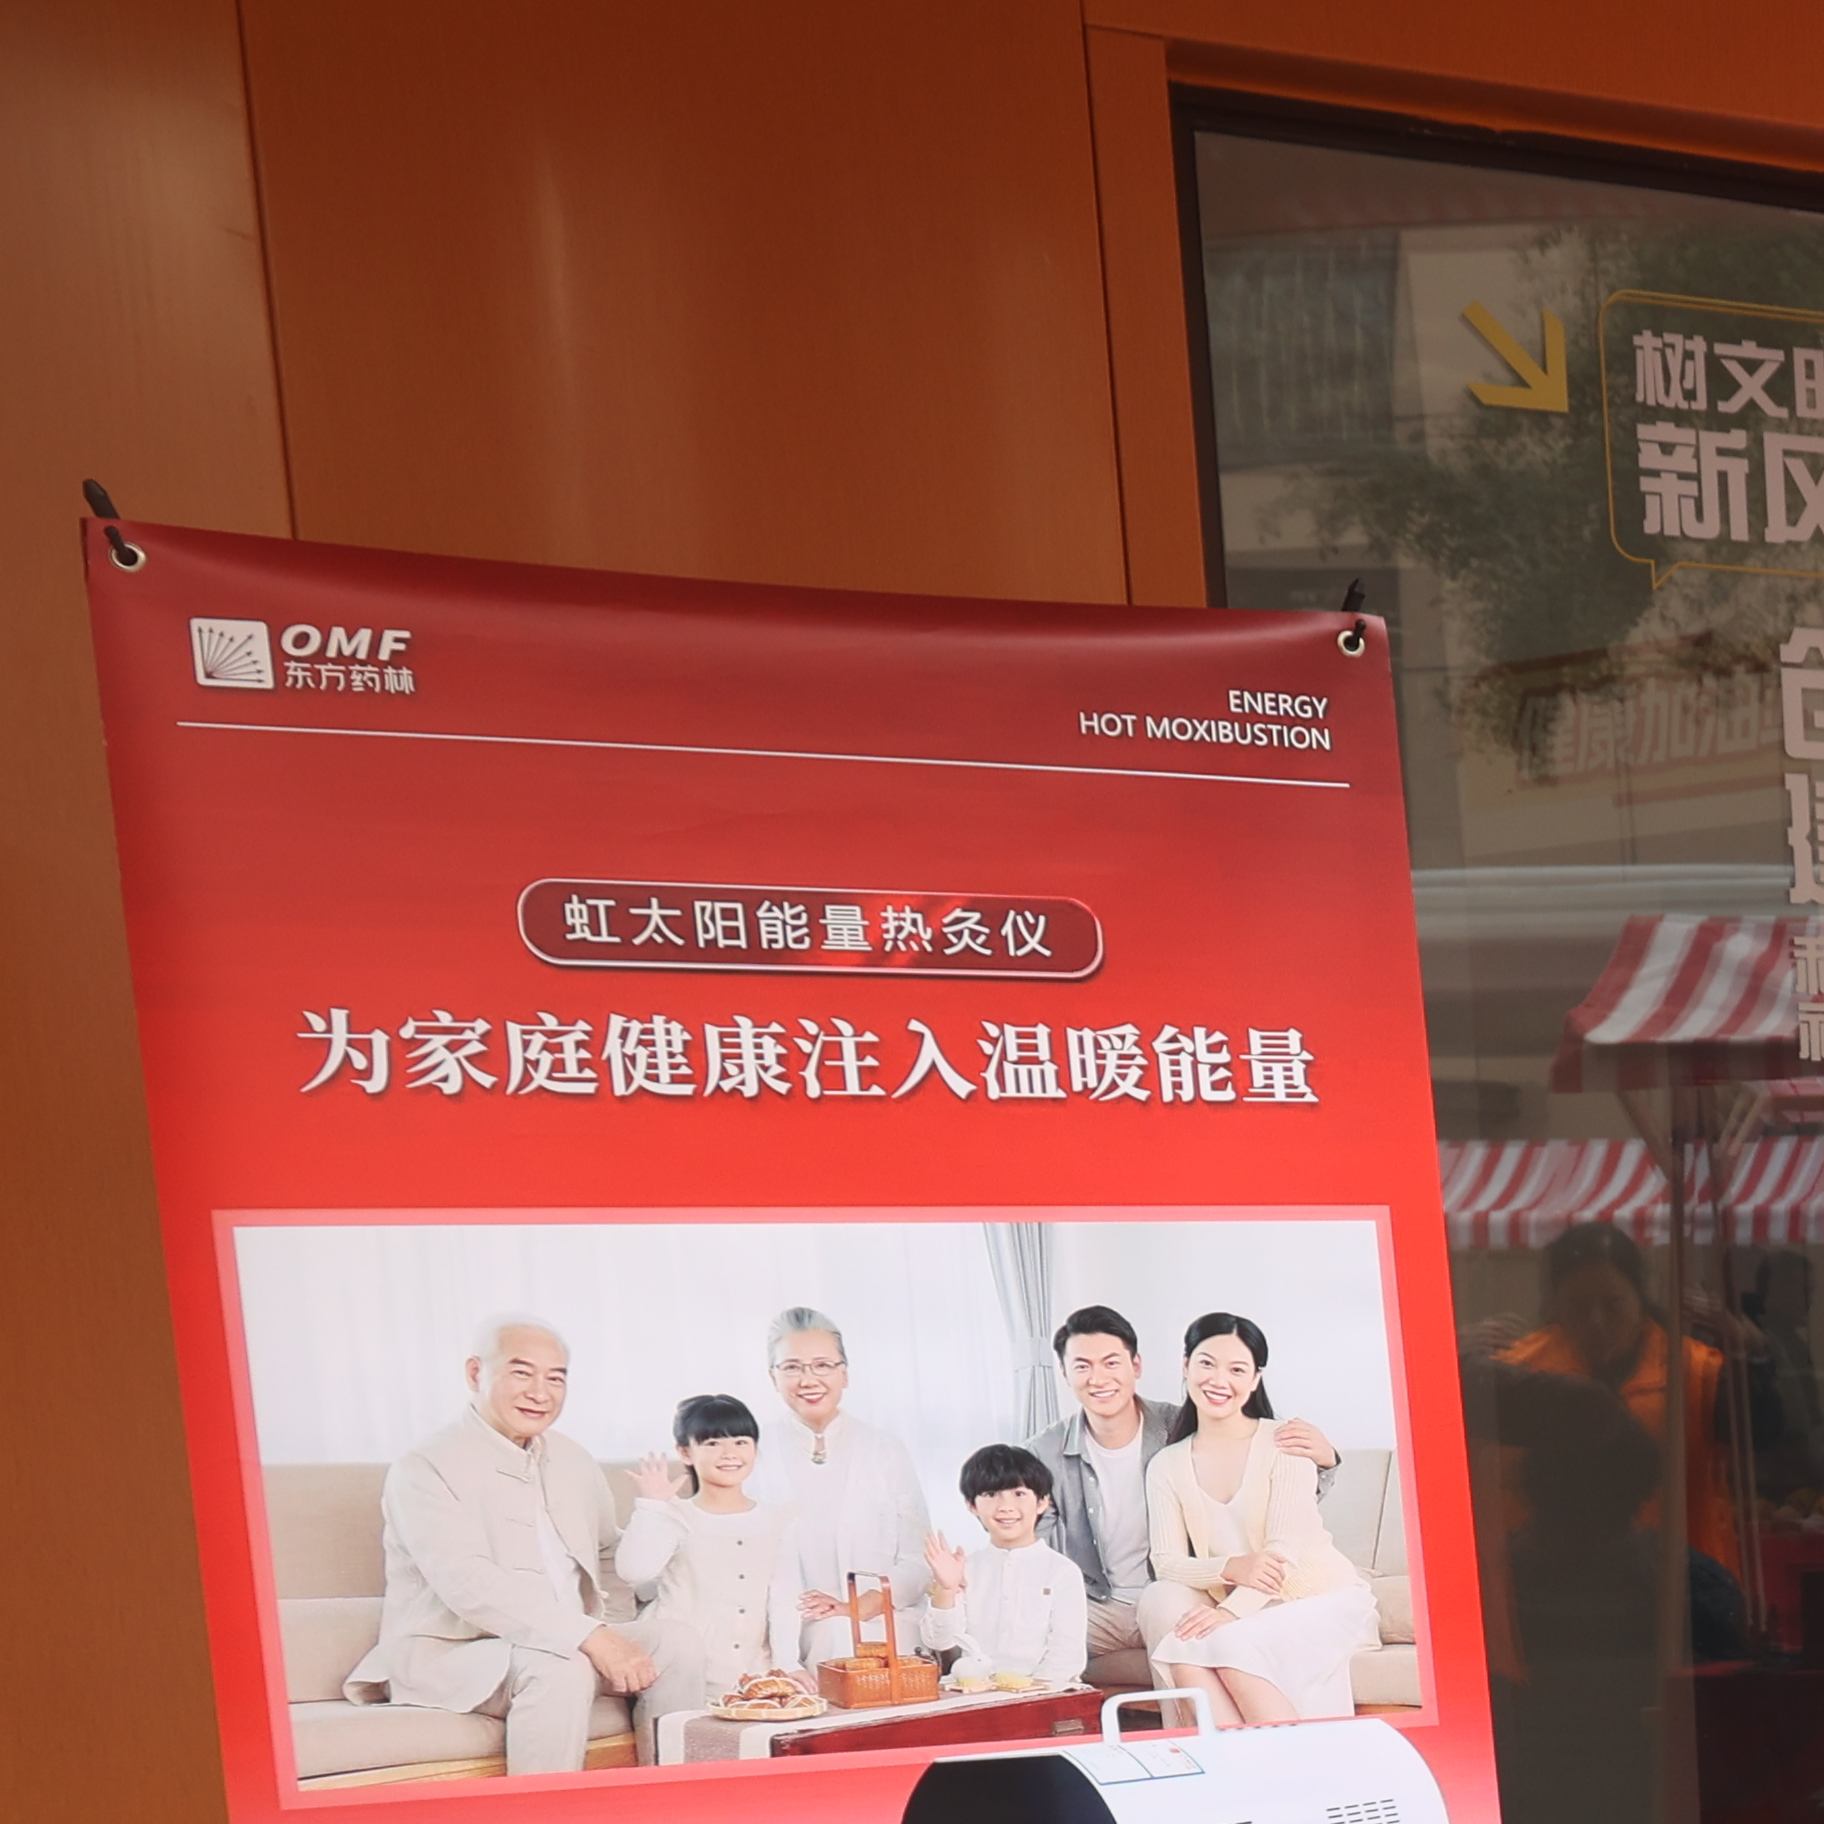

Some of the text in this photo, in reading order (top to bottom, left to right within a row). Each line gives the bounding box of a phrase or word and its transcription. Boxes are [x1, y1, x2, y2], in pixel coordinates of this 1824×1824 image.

[281, 625, 413, 662] OMF
[282, 660, 416, 695] 东方药林
[1227, 688, 1330, 721] ENERGY
[1078, 709, 1333, 751] HOT MOXIBUSTION
[563, 891, 1054, 960] 虹太阳能量热灸仪
[295, 1006, 1320, 1106] 为家庭健康注入温暖能量
